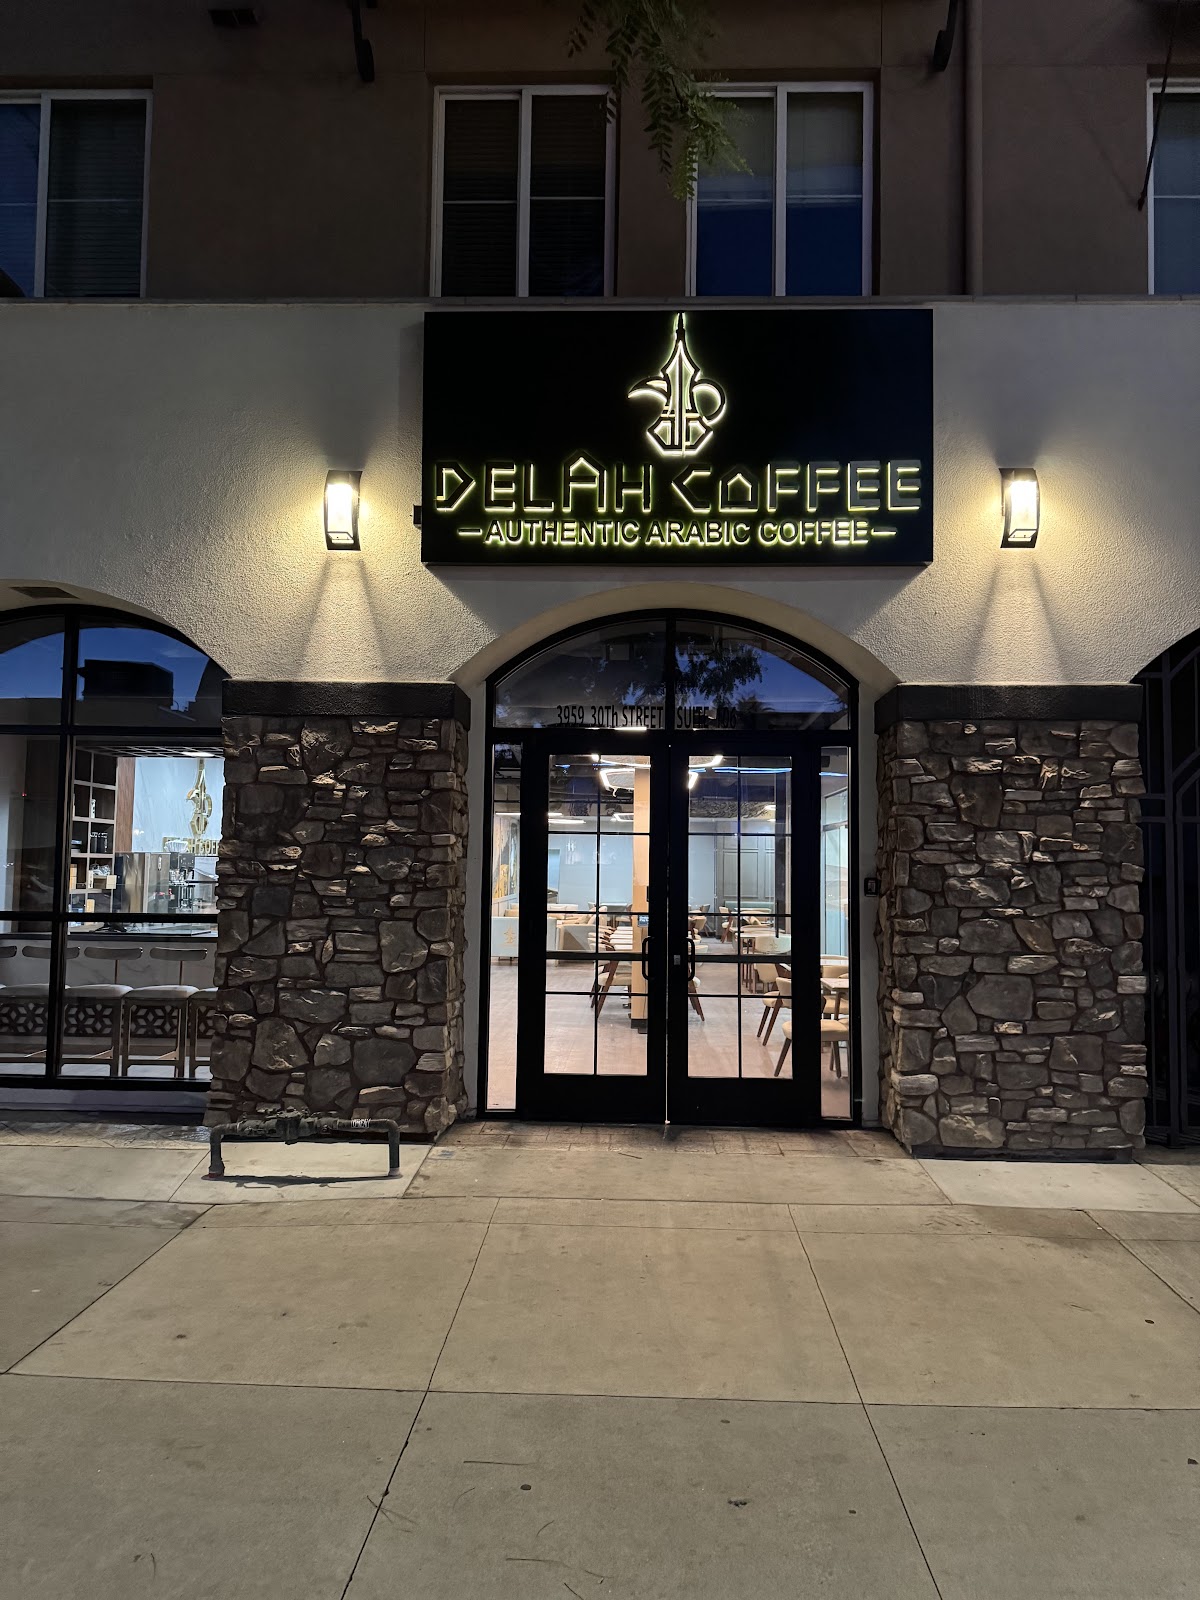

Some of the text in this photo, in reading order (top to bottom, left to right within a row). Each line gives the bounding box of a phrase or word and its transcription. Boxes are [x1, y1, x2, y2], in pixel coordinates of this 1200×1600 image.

[435, 450, 921, 512] DELAH COFFEE
[484, 518, 869, 545] AUTHENTIC ARABIC COFFEE
[556, 705, 585, 725] 3959
[622, 705, 664, 728] STREET
[676, 706, 710, 729] SUITE
